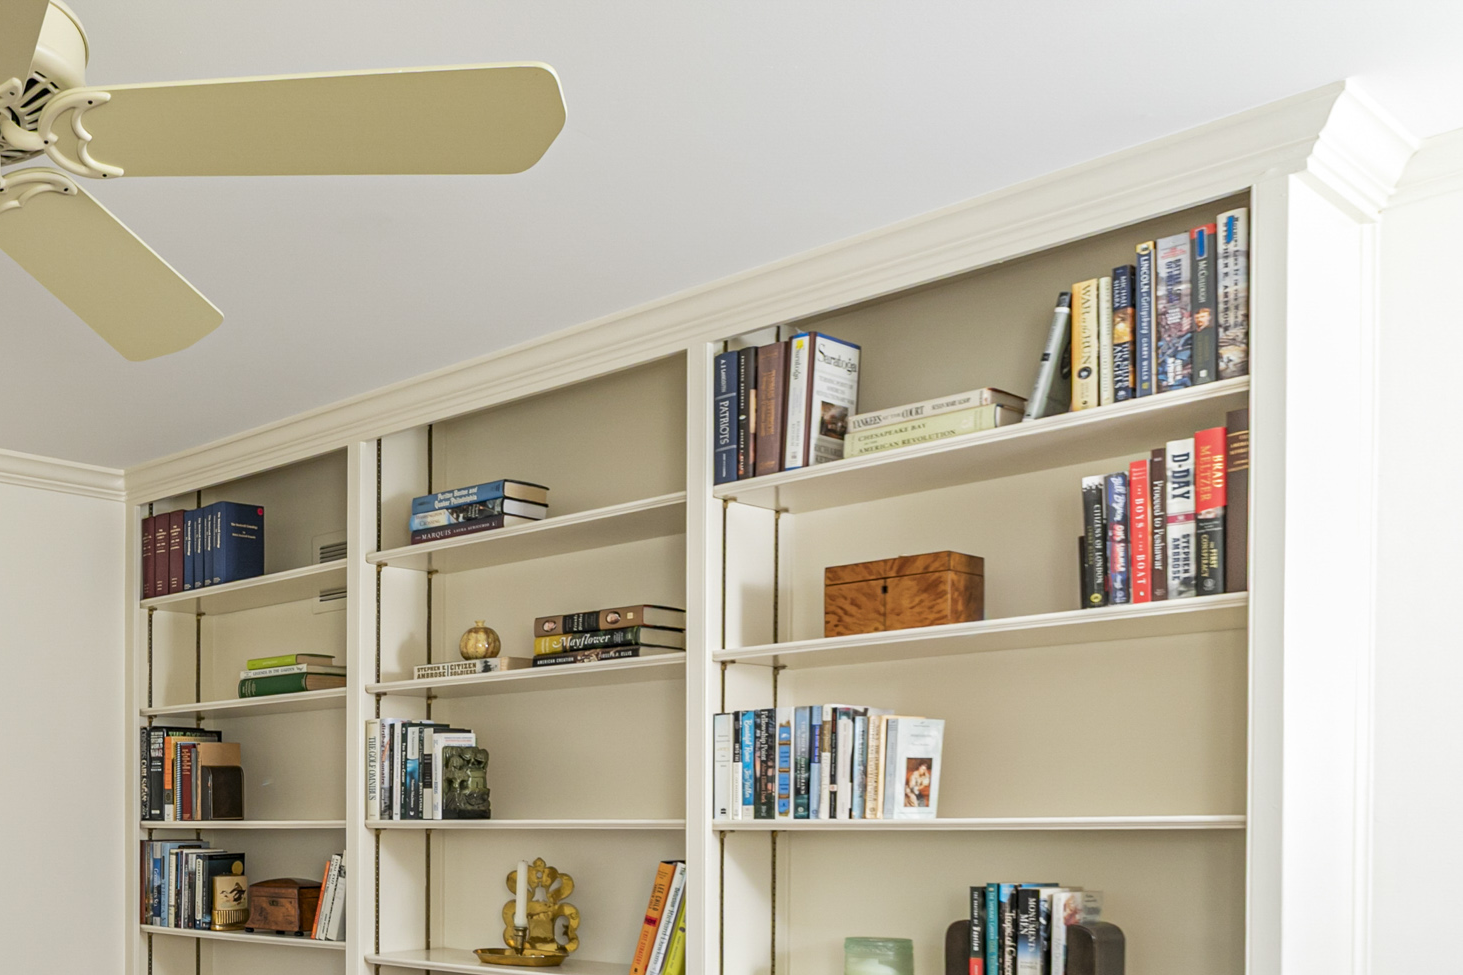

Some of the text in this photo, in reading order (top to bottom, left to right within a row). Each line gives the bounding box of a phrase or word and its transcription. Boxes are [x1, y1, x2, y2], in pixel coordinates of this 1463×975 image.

[1140, 256, 1150, 292] LINCOLN
[1081, 285, 1092, 365] WAR RUN
[817, 343, 857, 375] Saratoga
[1141, 338, 1149, 380] GARRY WILLS
[719, 401, 729, 445] PATRIOTS
[902, 406, 924, 418] COURT
[858, 426, 908, 442] CHESAPEAKE
[858, 429, 956, 454] AMERICAN REVOLUTION
[1199, 445, 1212, 502] MELTZER
[1212, 455, 1224, 488] BRAD
[1110, 476, 1126, 522] Bill Bryson
[421, 529, 451, 540] MARQUIS
[1093, 504, 1101, 538] CITIZENS
[1153, 480, 1164, 570] Proceed to Peshawar
[1134, 498, 1146, 585] BOYS BOAT
[1182, 534, 1191, 574] STEPHEN
[1201, 534, 1209, 577] CONSPIRACY
[1095, 552, 1103, 584] LONDON
[1172, 538, 1181, 581] AMBROSE
[1210, 549, 1218, 569] FIRST
[552, 634, 611, 649] Mayflower
[417, 671, 447, 680] AMBROSE
[450, 662, 477, 670] CITIZEN
[450, 669, 477, 677] SOLDIERS
[760, 711, 768, 743] Fellowship
[369, 751, 377, 769] GOLF
[369, 770, 377, 800] OMNIBUS
[652, 896, 663, 911] CHILD
[653, 909, 674, 965] Richard Dawkins
[1003, 910, 1016, 936] Tropic
[1020, 914, 1028, 935] MEN
[1028, 898, 1036, 952] MONUMENTS
